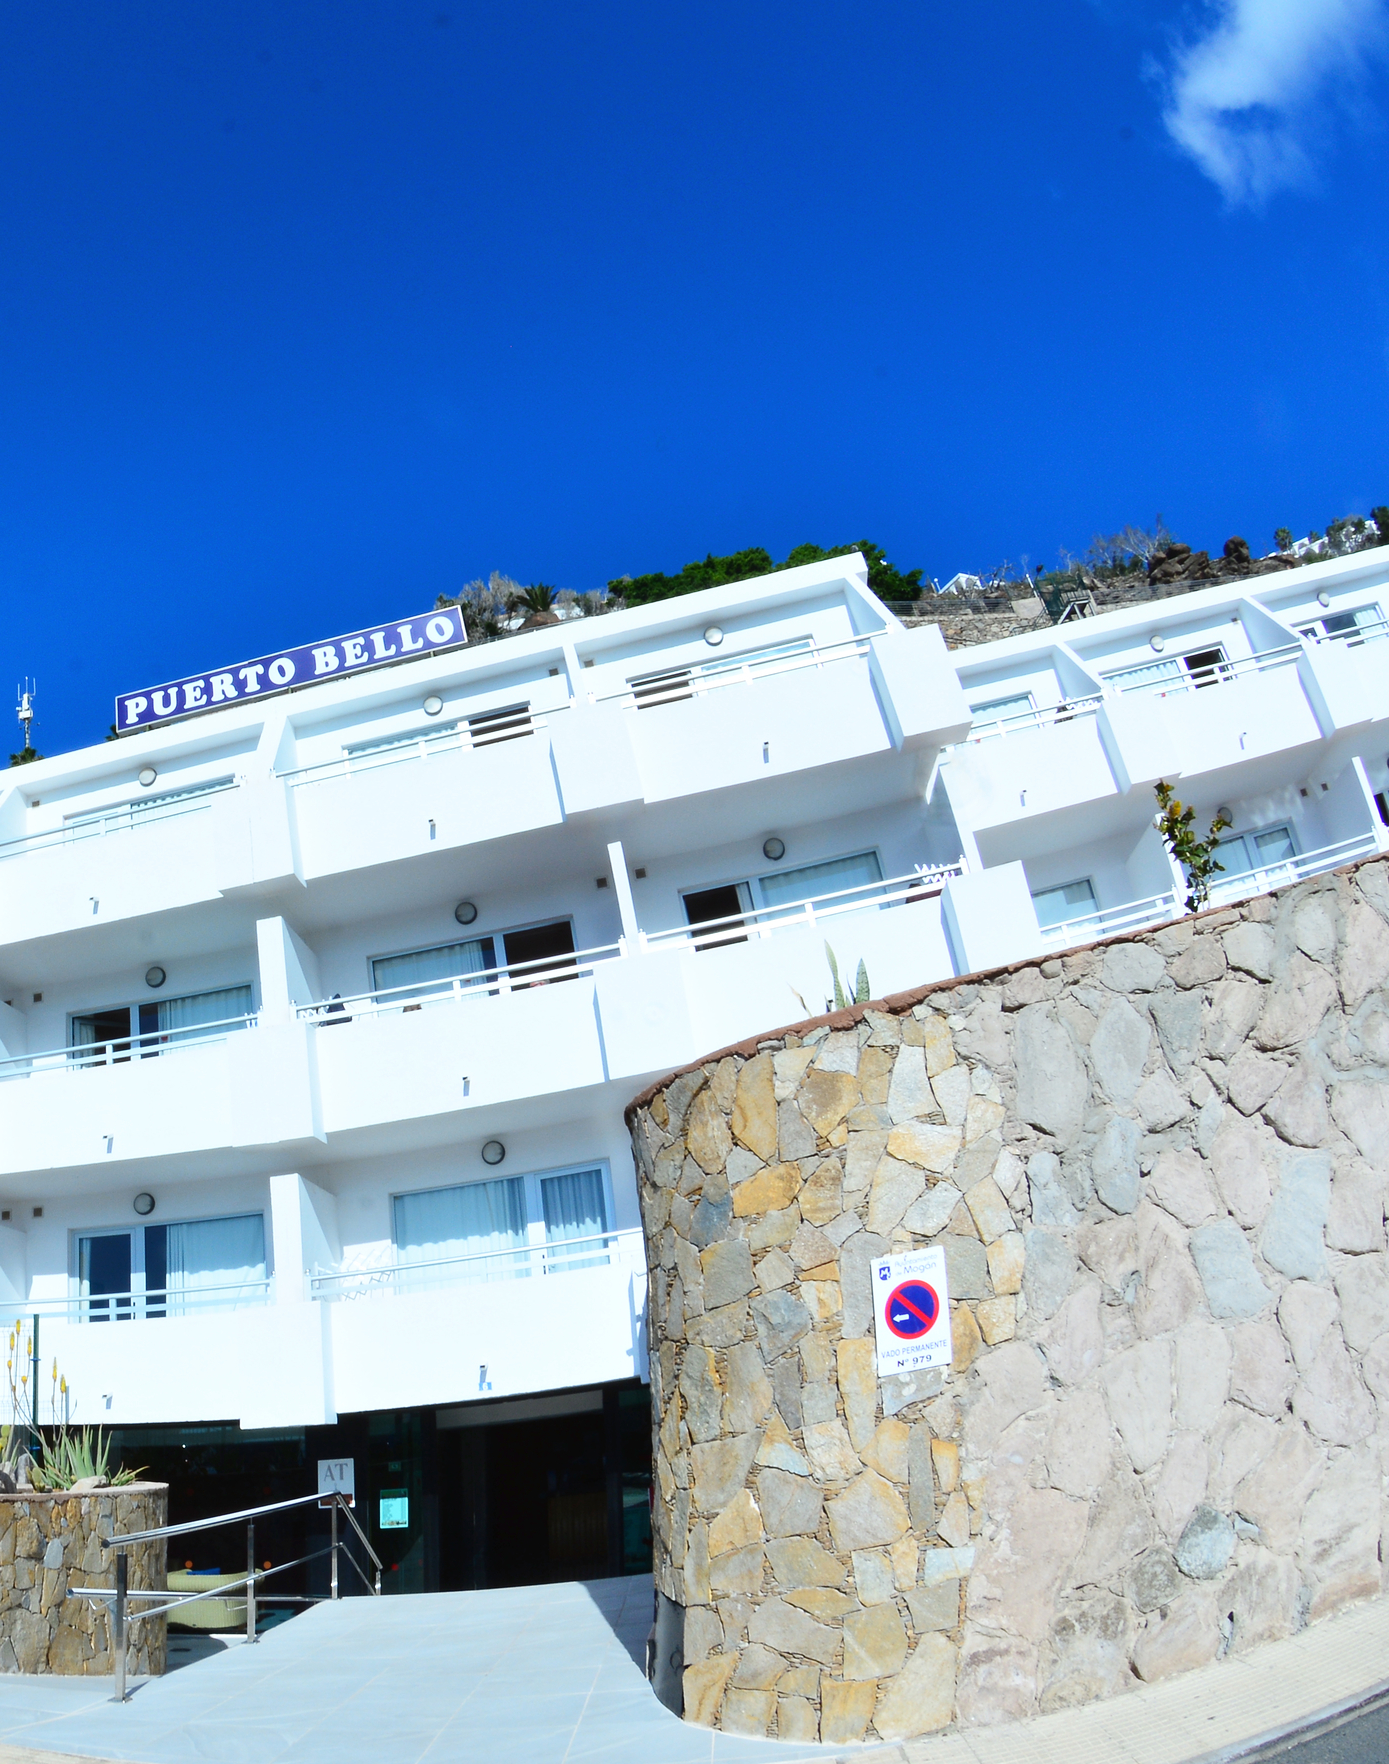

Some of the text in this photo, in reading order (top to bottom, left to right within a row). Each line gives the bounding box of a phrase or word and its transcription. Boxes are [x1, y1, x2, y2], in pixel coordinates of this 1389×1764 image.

[124, 616, 455, 725] PUERTO BELLO
[881, 1339, 947, 1359] VADO PERMANENTE
[912, 1354, 932, 1365] 979
[324, 1463, 348, 1481] AT
